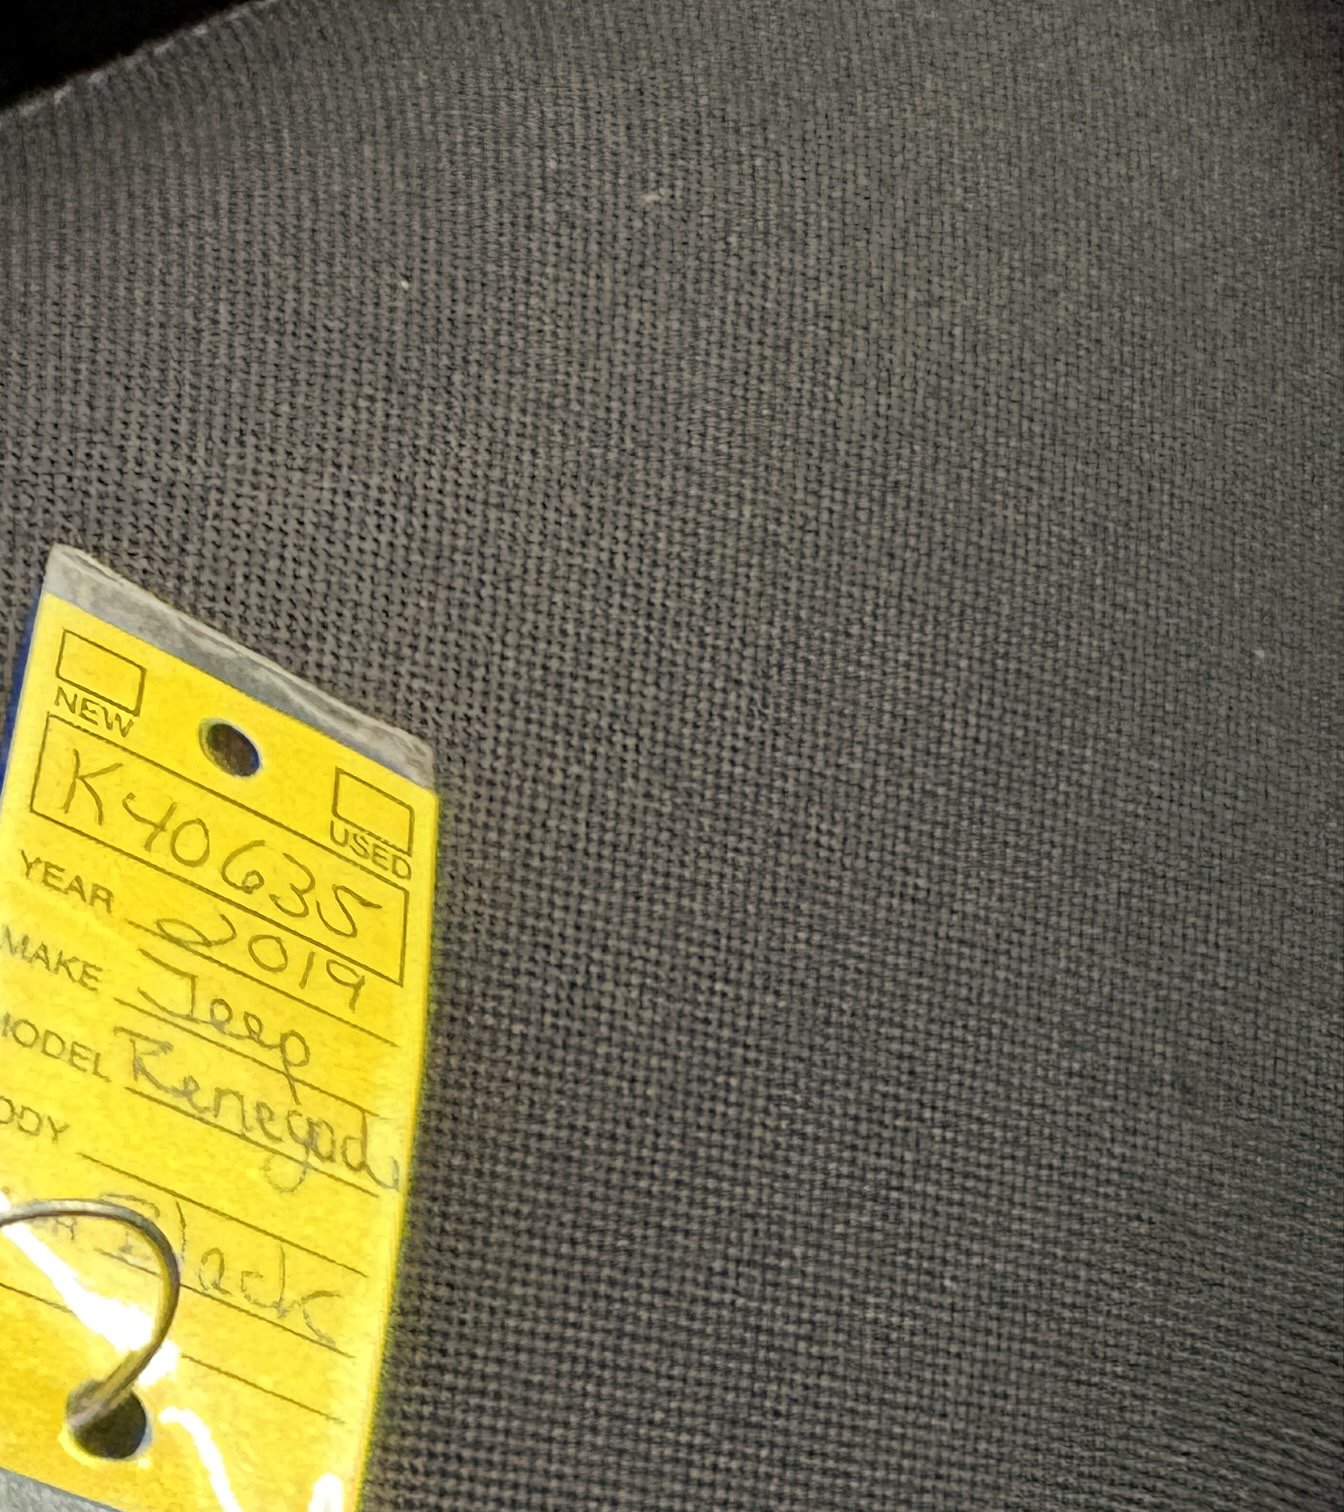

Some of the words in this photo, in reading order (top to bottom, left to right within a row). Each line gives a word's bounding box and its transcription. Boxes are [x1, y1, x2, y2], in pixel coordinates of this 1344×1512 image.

[54, 686, 135, 738] NEW
[20, 849, 116, 914] YEAR
[329, 820, 412, 880] USED
[0, 924, 104, 993] MAKE
[155, 914, 366, 1013] 2019
[136, 947, 311, 1105] Jeep
